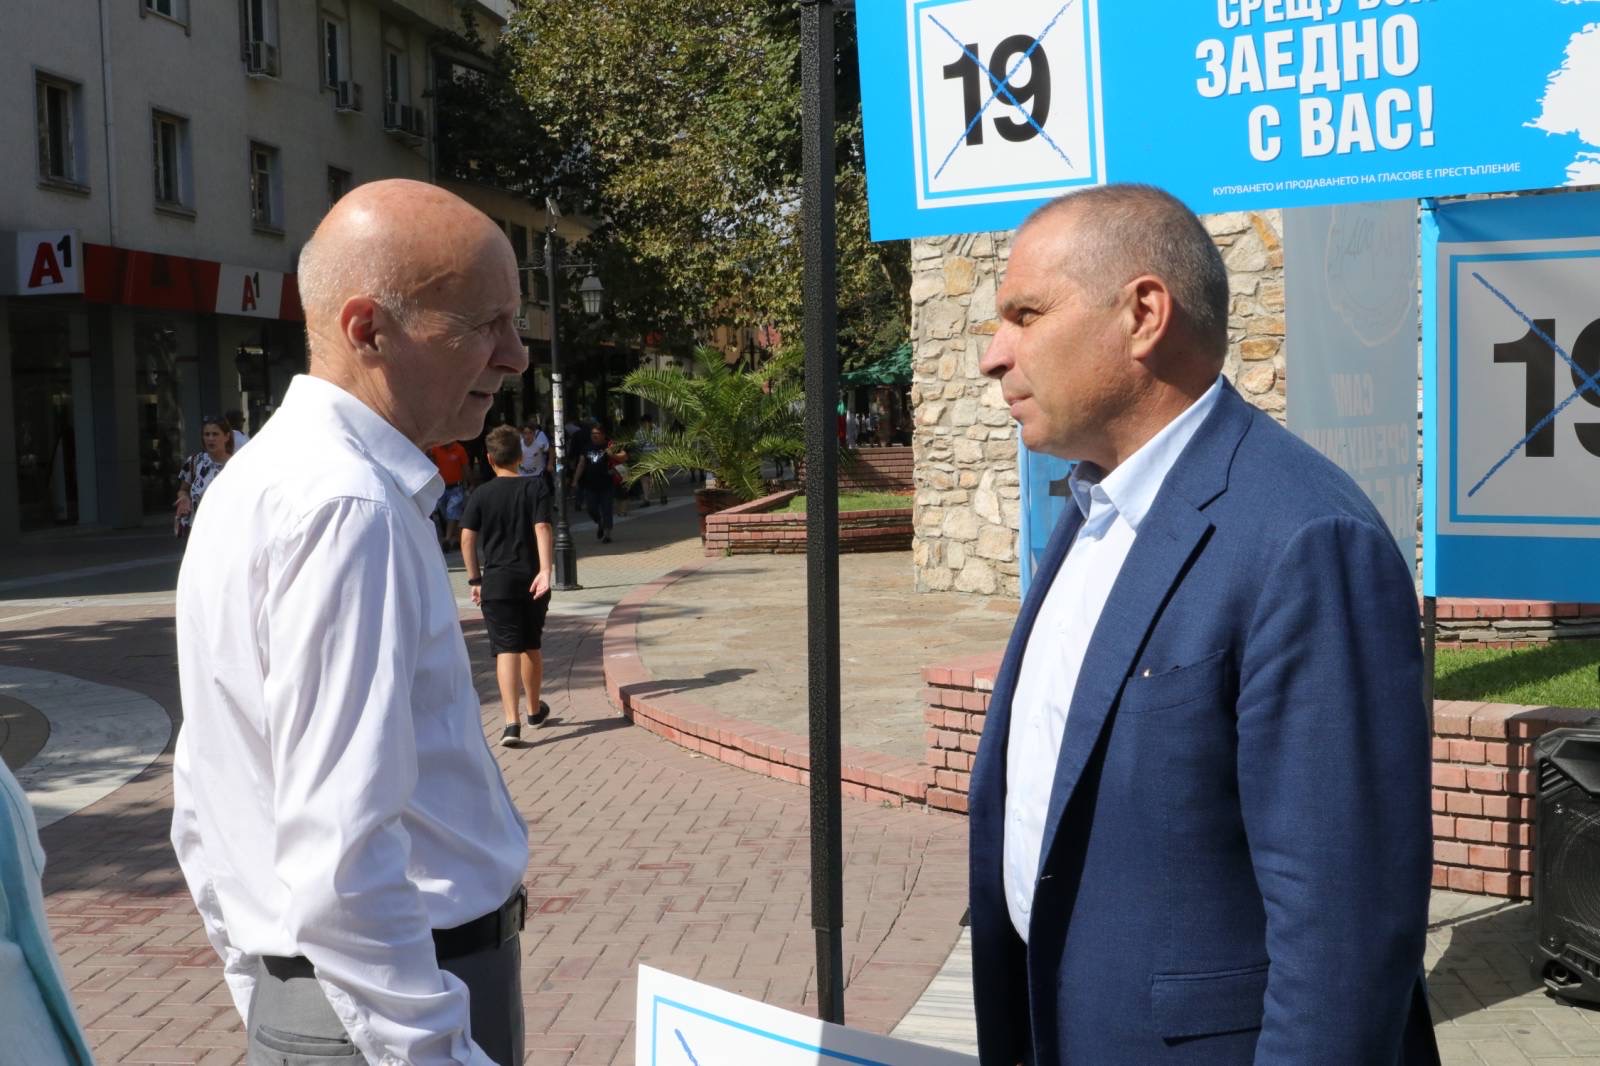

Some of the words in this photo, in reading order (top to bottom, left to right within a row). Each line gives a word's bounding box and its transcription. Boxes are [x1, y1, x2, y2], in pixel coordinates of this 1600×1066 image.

[1194, 13, 1420, 98] ЗАЕДНО
[942, 33, 1052, 146] 19
[1248, 104, 1282, 162] С
[1299, 84, 1435, 158] ВАС!
[1213, 182, 1274, 196] КУПУВАНЕТО
[1276, 181, 1284, 191] И
[1285, 175, 1359, 191] ПРОДАВАНЕТО
[1361, 174, 1376, 185] НА
[1378, 169, 1424, 183] ГЛАСОВЕ
[1426, 169, 1433, 179] Е
[1434, 161, 1521, 178] ПРЕСТЪПЛЕНИЕ
[28, 234, 73, 289] A1
[241, 271, 261, 312] A1
